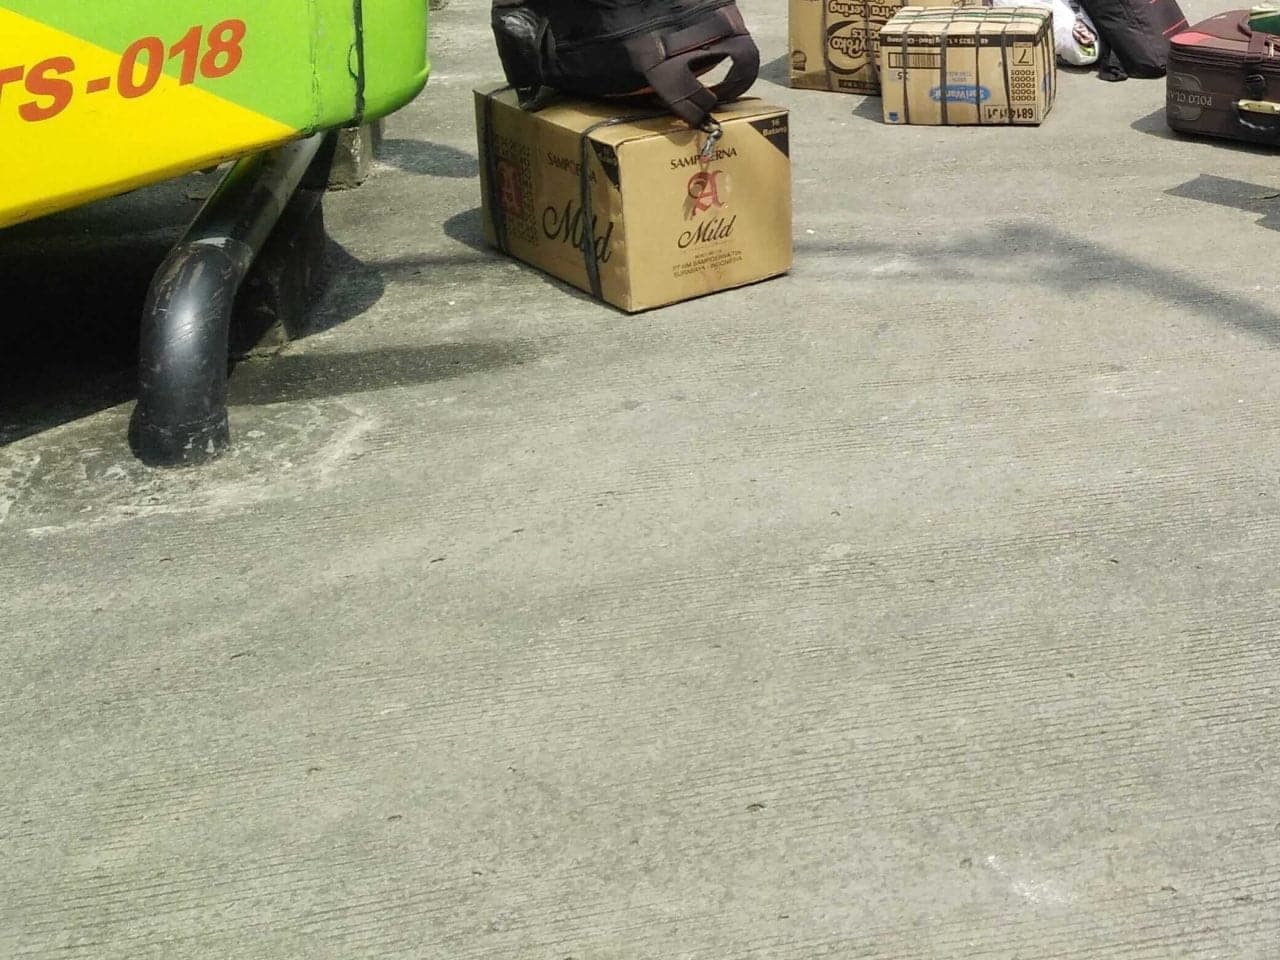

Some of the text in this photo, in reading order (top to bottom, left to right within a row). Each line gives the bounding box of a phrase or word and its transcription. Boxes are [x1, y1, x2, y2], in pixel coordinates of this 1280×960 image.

[1018, 48, 1030, 64] 7
[670, 147, 738, 170] SAMPERNA
[542, 199, 614, 263] Mld
[677, 214, 737, 249] Mild
